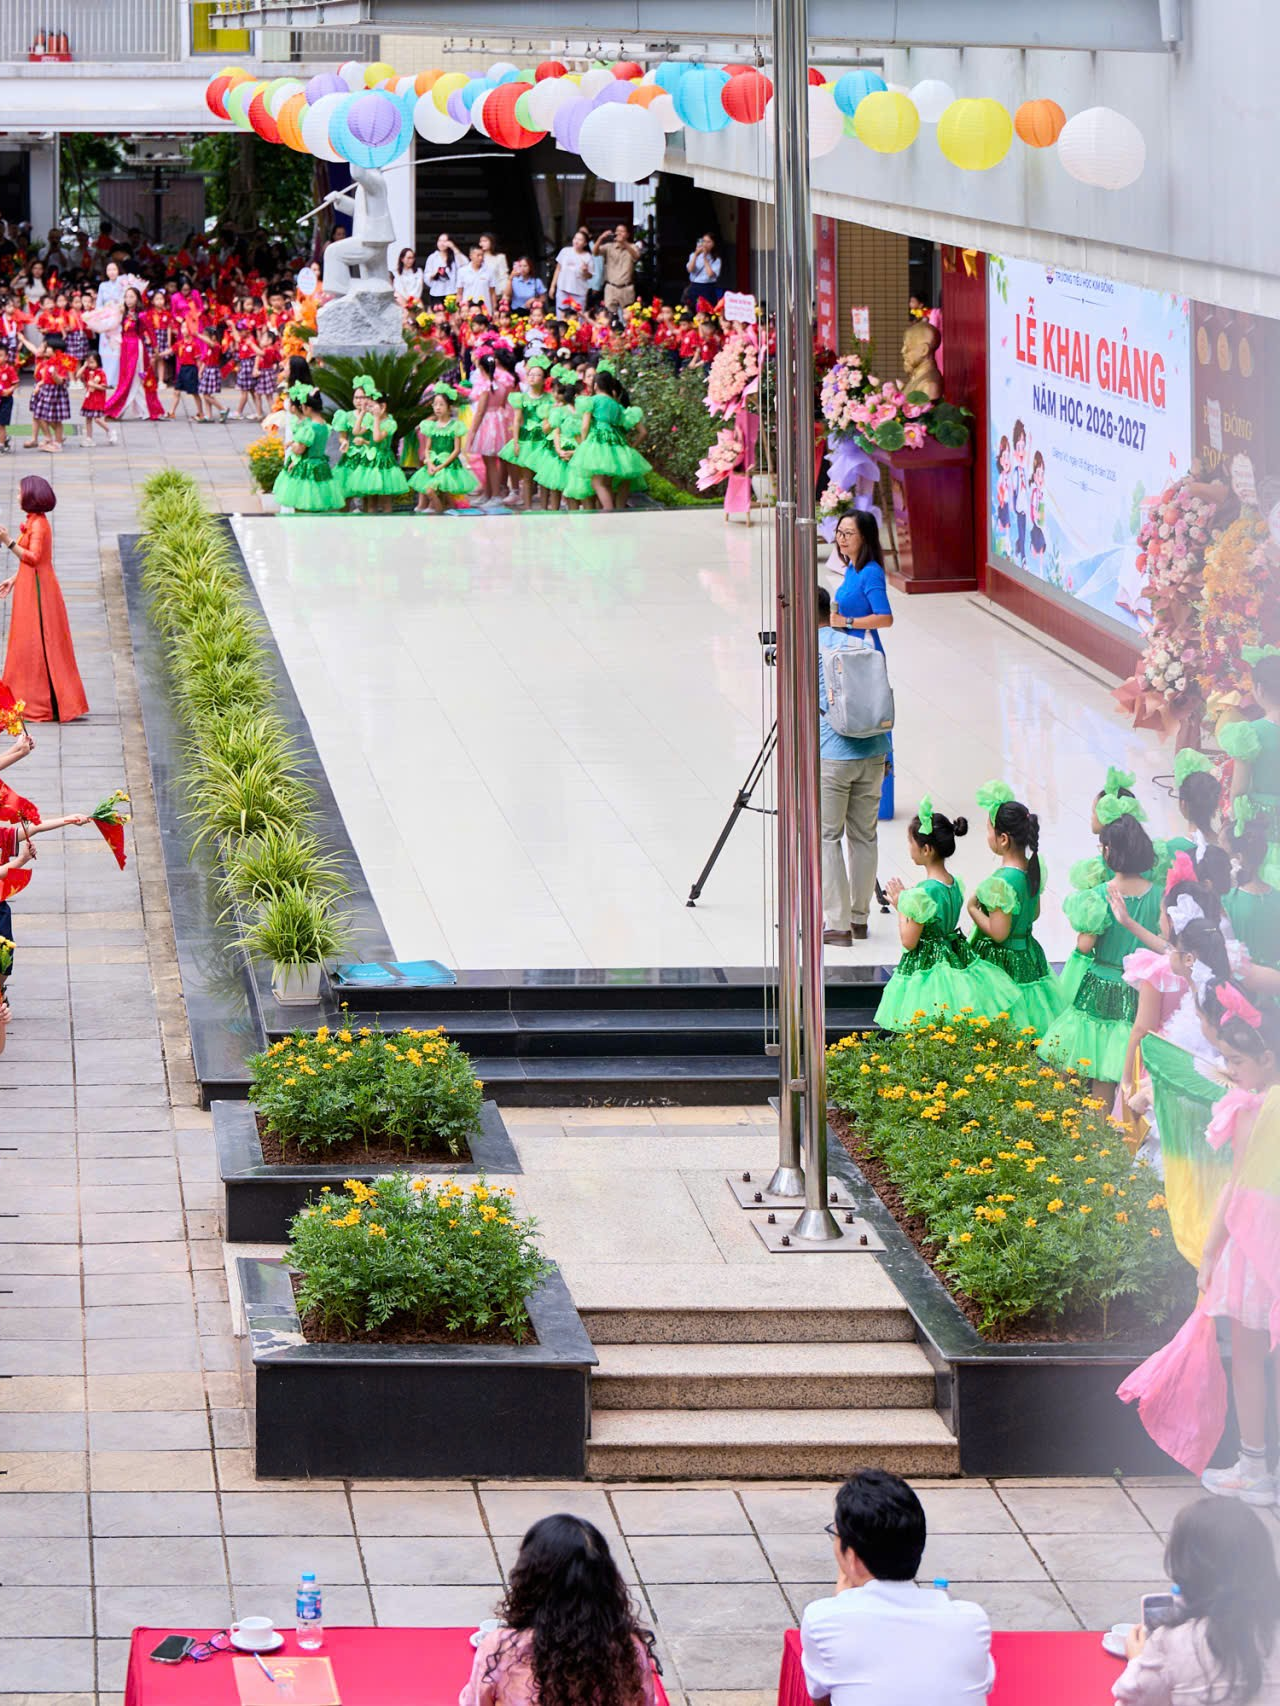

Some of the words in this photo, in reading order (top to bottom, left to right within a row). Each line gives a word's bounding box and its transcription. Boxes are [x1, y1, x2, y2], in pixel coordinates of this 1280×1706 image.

[1015, 296, 1037, 366] LỄ
[1043, 321, 1090, 384] KHAI
[1096, 326, 1166, 409] GIẢNG
[1033, 382, 1056, 418] NĂM
[1060, 394, 1083, 432] HỌC
[1086, 404, 1146, 451] 2026-2027
